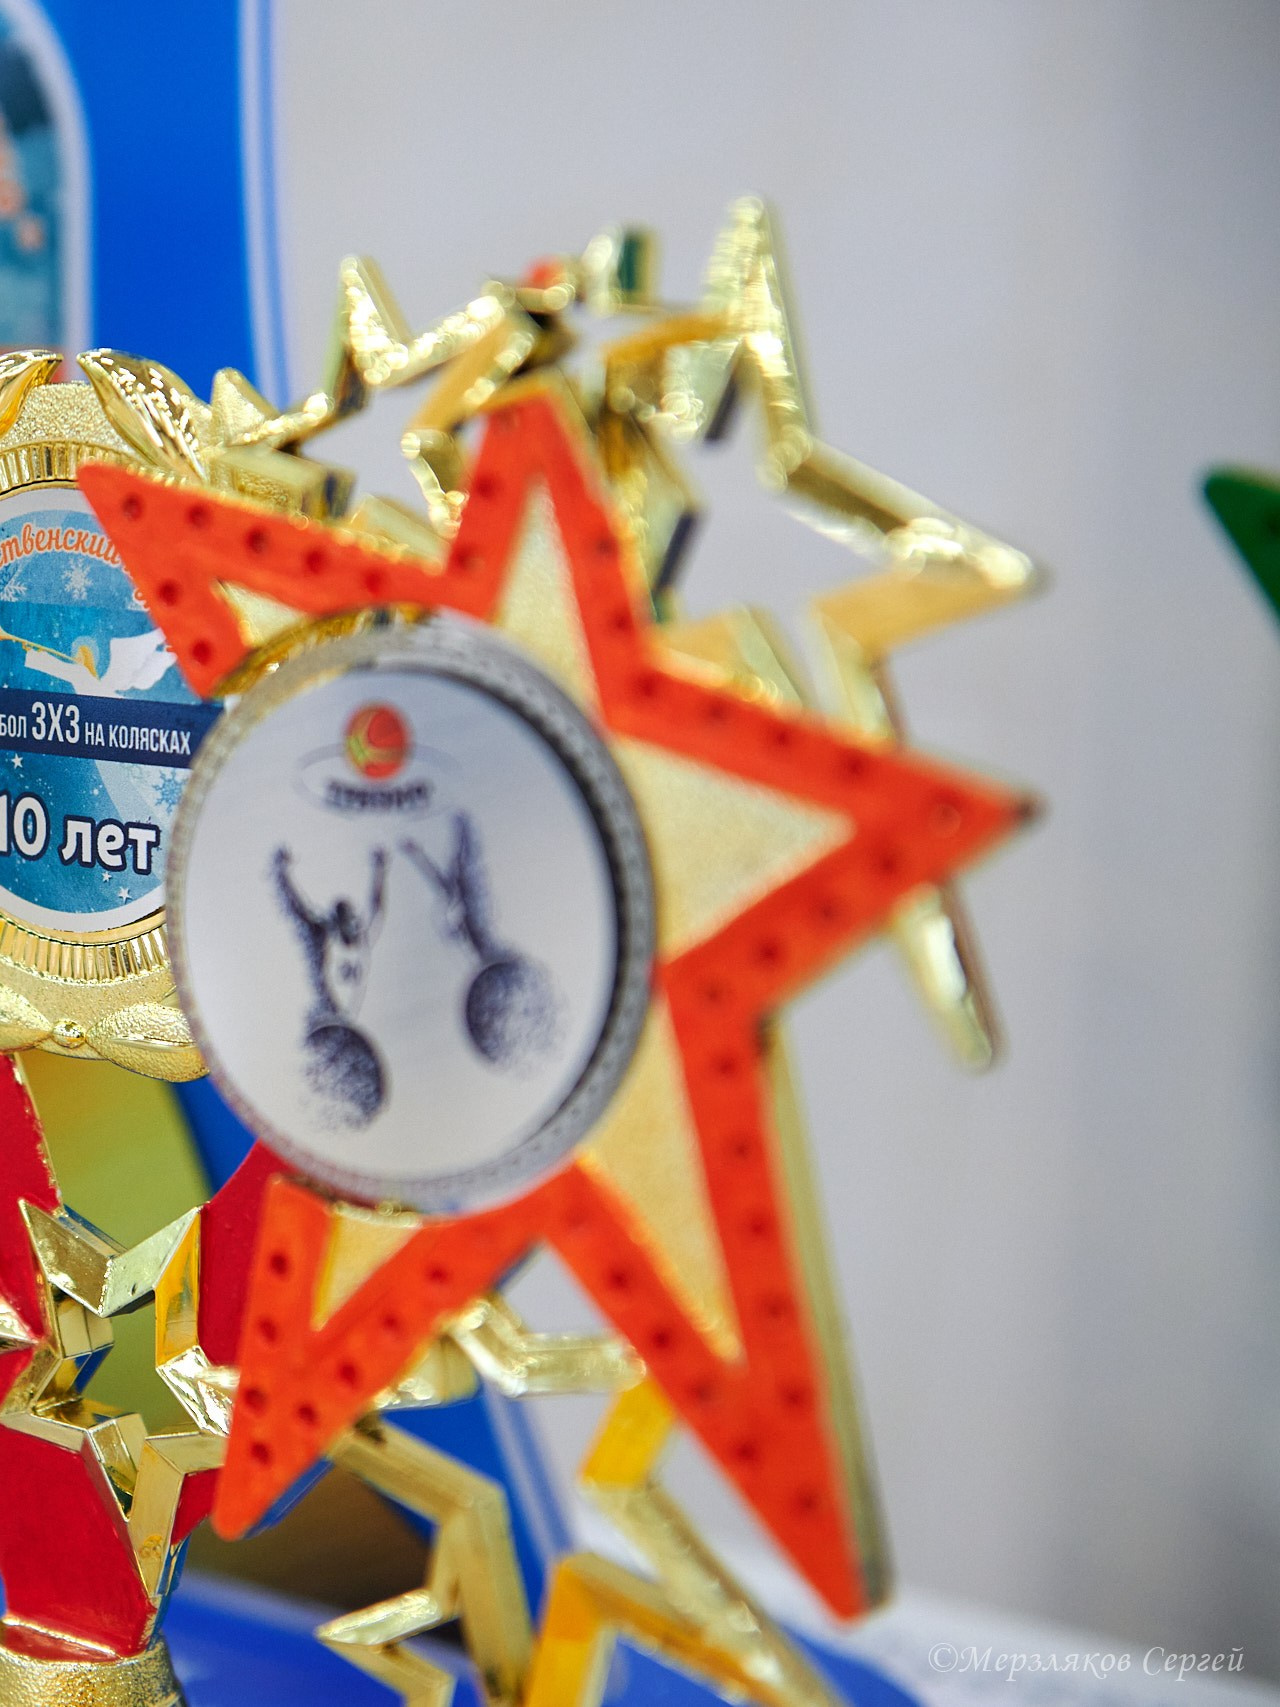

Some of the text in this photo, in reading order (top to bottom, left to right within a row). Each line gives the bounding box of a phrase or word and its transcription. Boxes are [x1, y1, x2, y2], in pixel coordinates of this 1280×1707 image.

[85, 722, 105, 746] НА
[109, 724, 191, 755] КОЛЯСКАХ
[61, 819, 157, 871] лет
